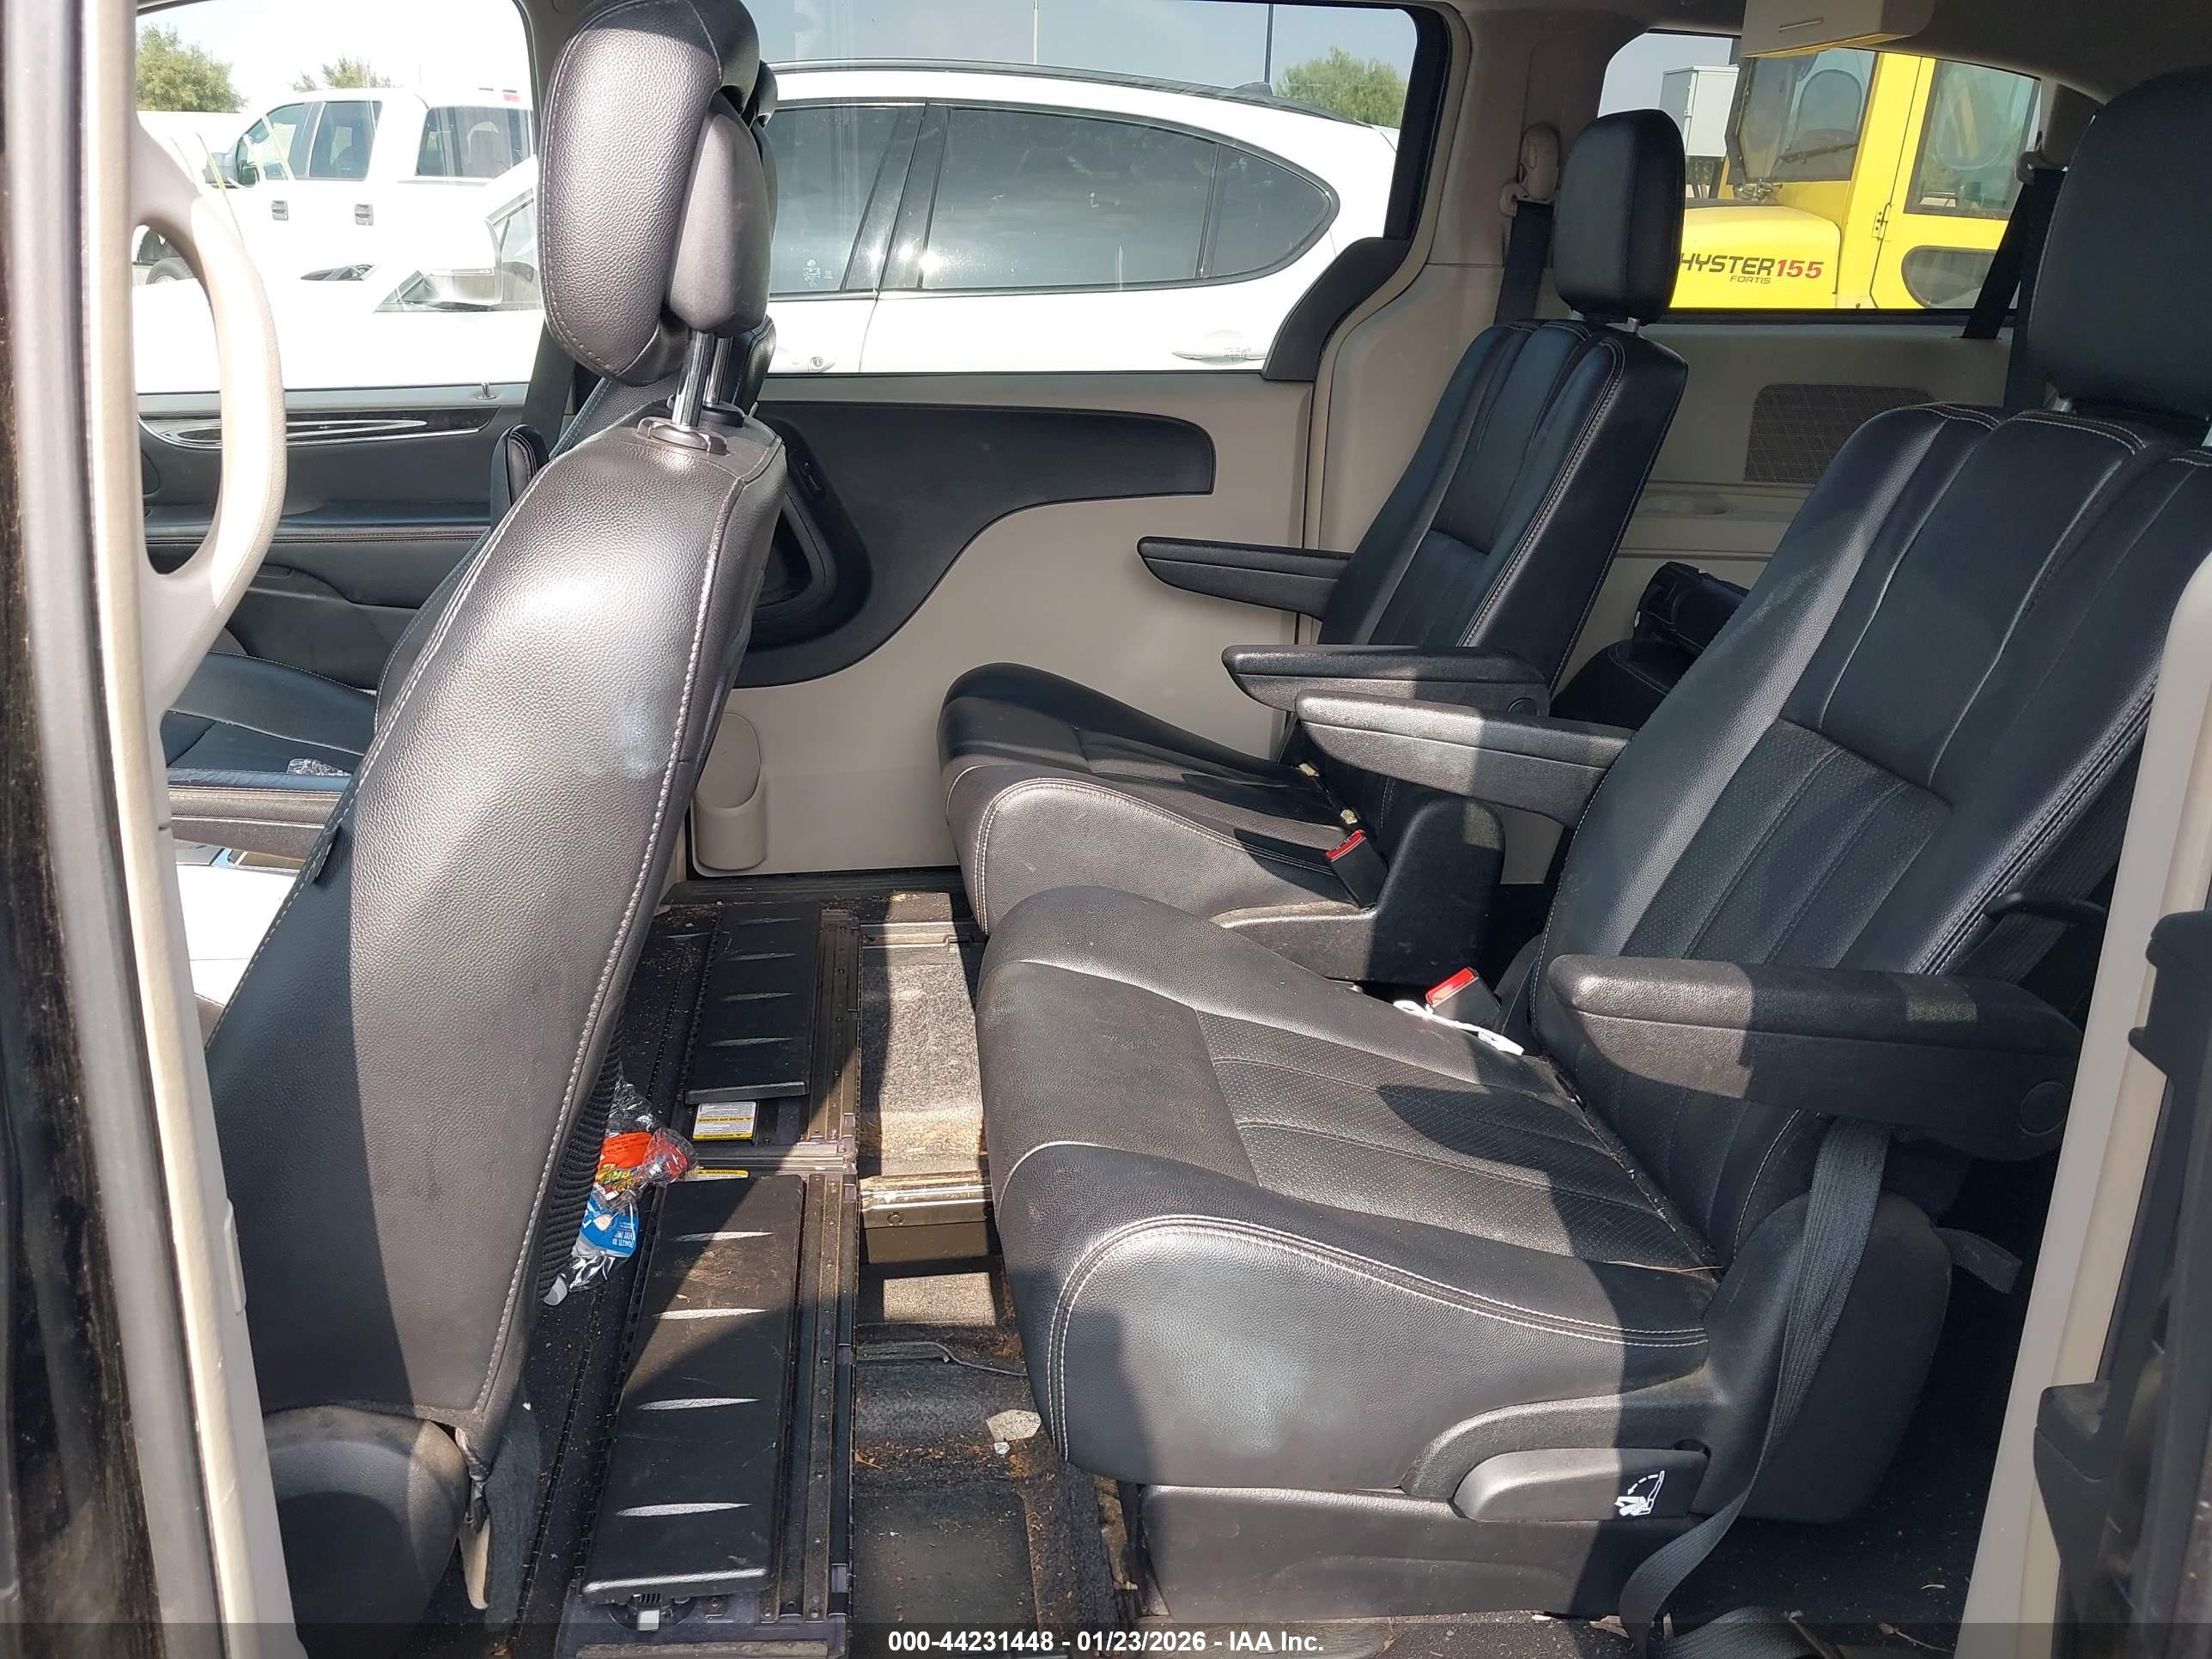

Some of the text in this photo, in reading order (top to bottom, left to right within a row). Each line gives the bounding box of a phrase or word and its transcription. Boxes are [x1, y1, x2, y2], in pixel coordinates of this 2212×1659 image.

[1680, 252, 1824, 279] HYSTER 155
[1729, 275, 1771, 284] FORTIS
